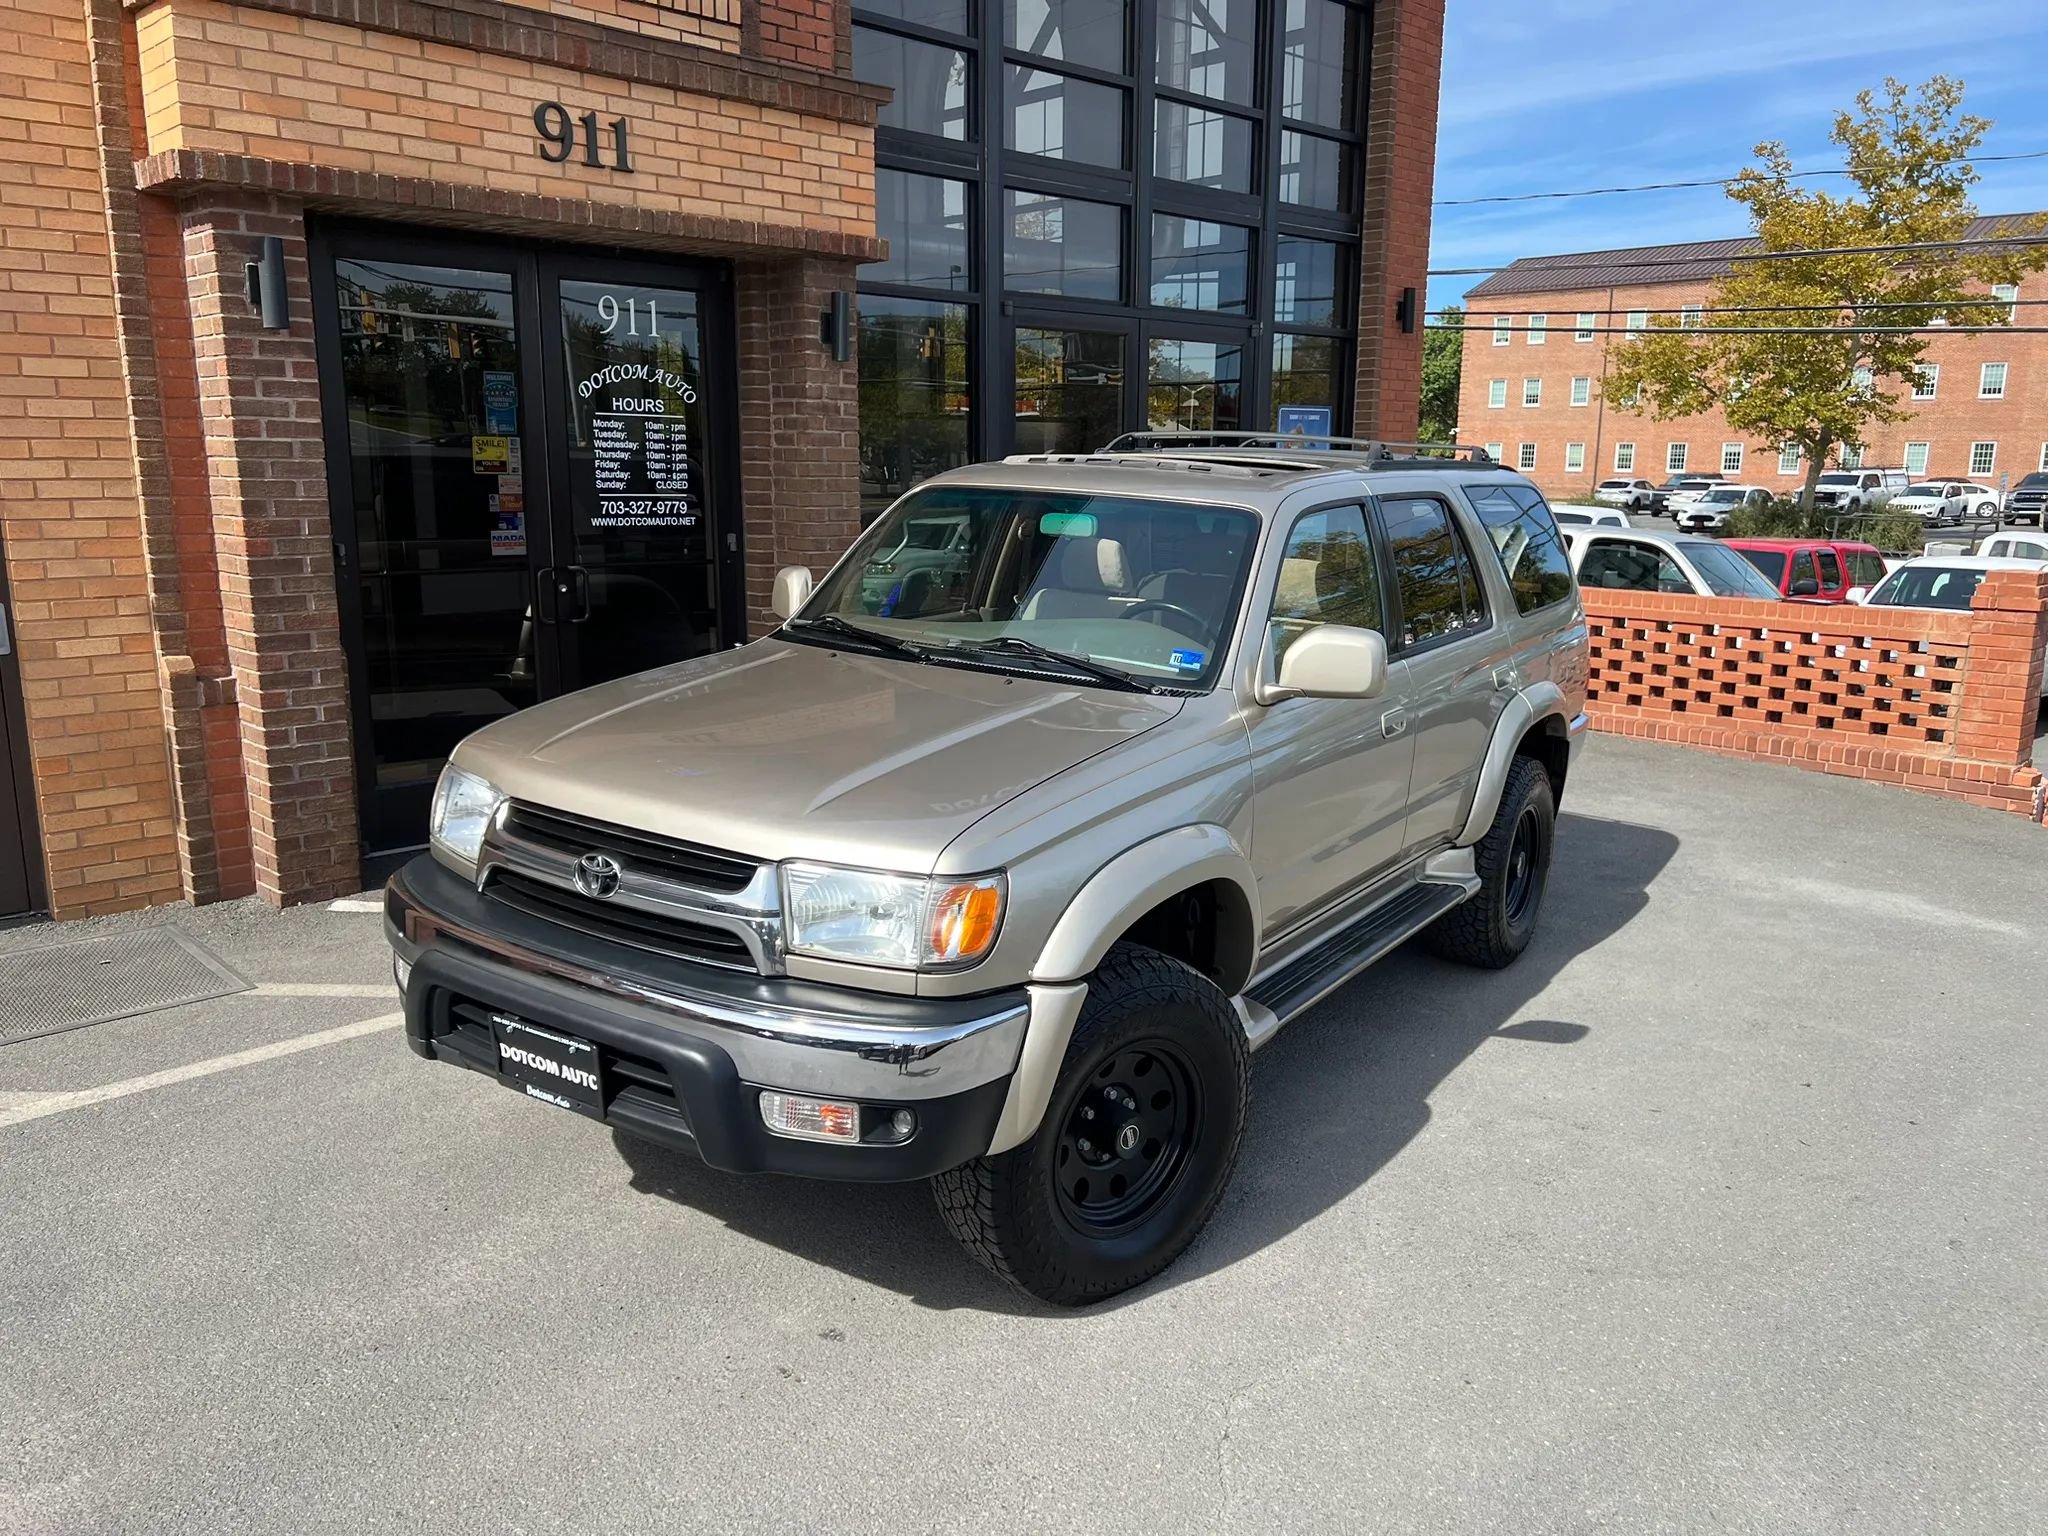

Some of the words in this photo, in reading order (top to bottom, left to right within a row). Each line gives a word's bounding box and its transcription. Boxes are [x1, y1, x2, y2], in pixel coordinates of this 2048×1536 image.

[533, 101, 634, 173] 911
[598, 295, 660, 337] 911
[578, 364, 649, 399] DOTCOM
[648, 369, 697, 403] AUTO
[612, 397, 665, 412] HOURS
[592, 419, 625, 430] Monday:
[645, 421, 664, 429] 10am
[593, 429, 627, 439] Tuesday:
[645, 431, 665, 439] 10am
[475, 440, 505, 448] SMILE!
[593, 440, 640, 450] Wednesday:
[645, 441, 665, 449] 10am
[594, 450, 631, 460] Thursday:
[646, 451, 666, 459] 10am
[594, 460, 621, 470] Friday:
[646, 461, 666, 469] 10am
[595, 470, 631, 480] Saturday:
[646, 471, 666, 479] 10am
[595, 480, 626, 490] Sunday:
[656, 481, 688, 489] CLOSED
[600, 501, 688, 514] 703-327-9779
[590, 517, 696, 526] WWW.DOTCOMAUTO.NET
[1173, 655, 1182, 663] 10
[499, 1042, 560, 1076] DOTCOM
